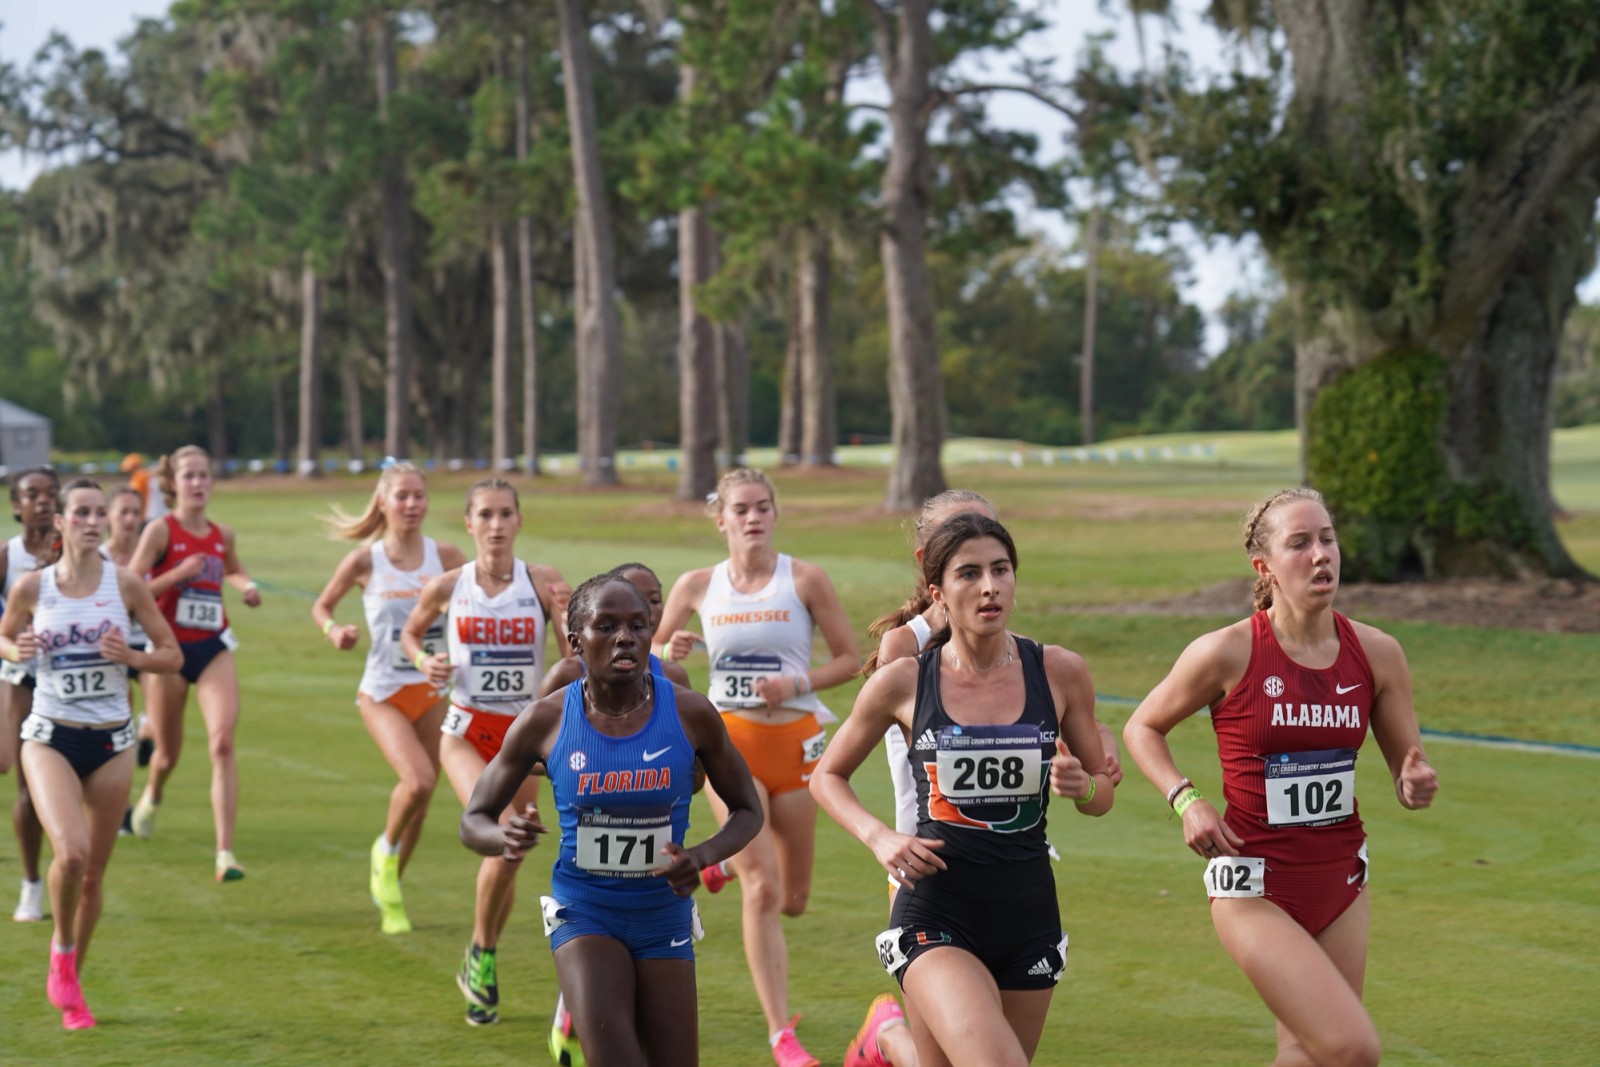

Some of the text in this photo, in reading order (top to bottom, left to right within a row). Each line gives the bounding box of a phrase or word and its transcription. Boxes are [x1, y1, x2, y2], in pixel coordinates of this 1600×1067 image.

[187, 604, 217, 622] 138
[710, 610, 791, 626] TENNESSEE
[456, 616, 536, 645] MERCER
[62, 671, 105, 694] 312
[481, 670, 524, 691] 263
[1265, 677, 1283, 695] SEC
[1271, 703, 1361, 728] ALABAMA
[952, 736, 1038, 745] CROSS COUNTRY CHAMPIONSHIPS
[570, 751, 586, 771] SEC
[1280, 765, 1297, 773] CROSS
[1297, 763, 1319, 772] COUNTRY
[1319, 759, 1354, 769] CHAMPIONSHIPS
[577, 767, 671, 795] FLORIDA
[953, 756, 1024, 791] 268
[1283, 778, 1343, 817] 102
[594, 833, 654, 865] 171
[1211, 864, 1252, 892] 102
